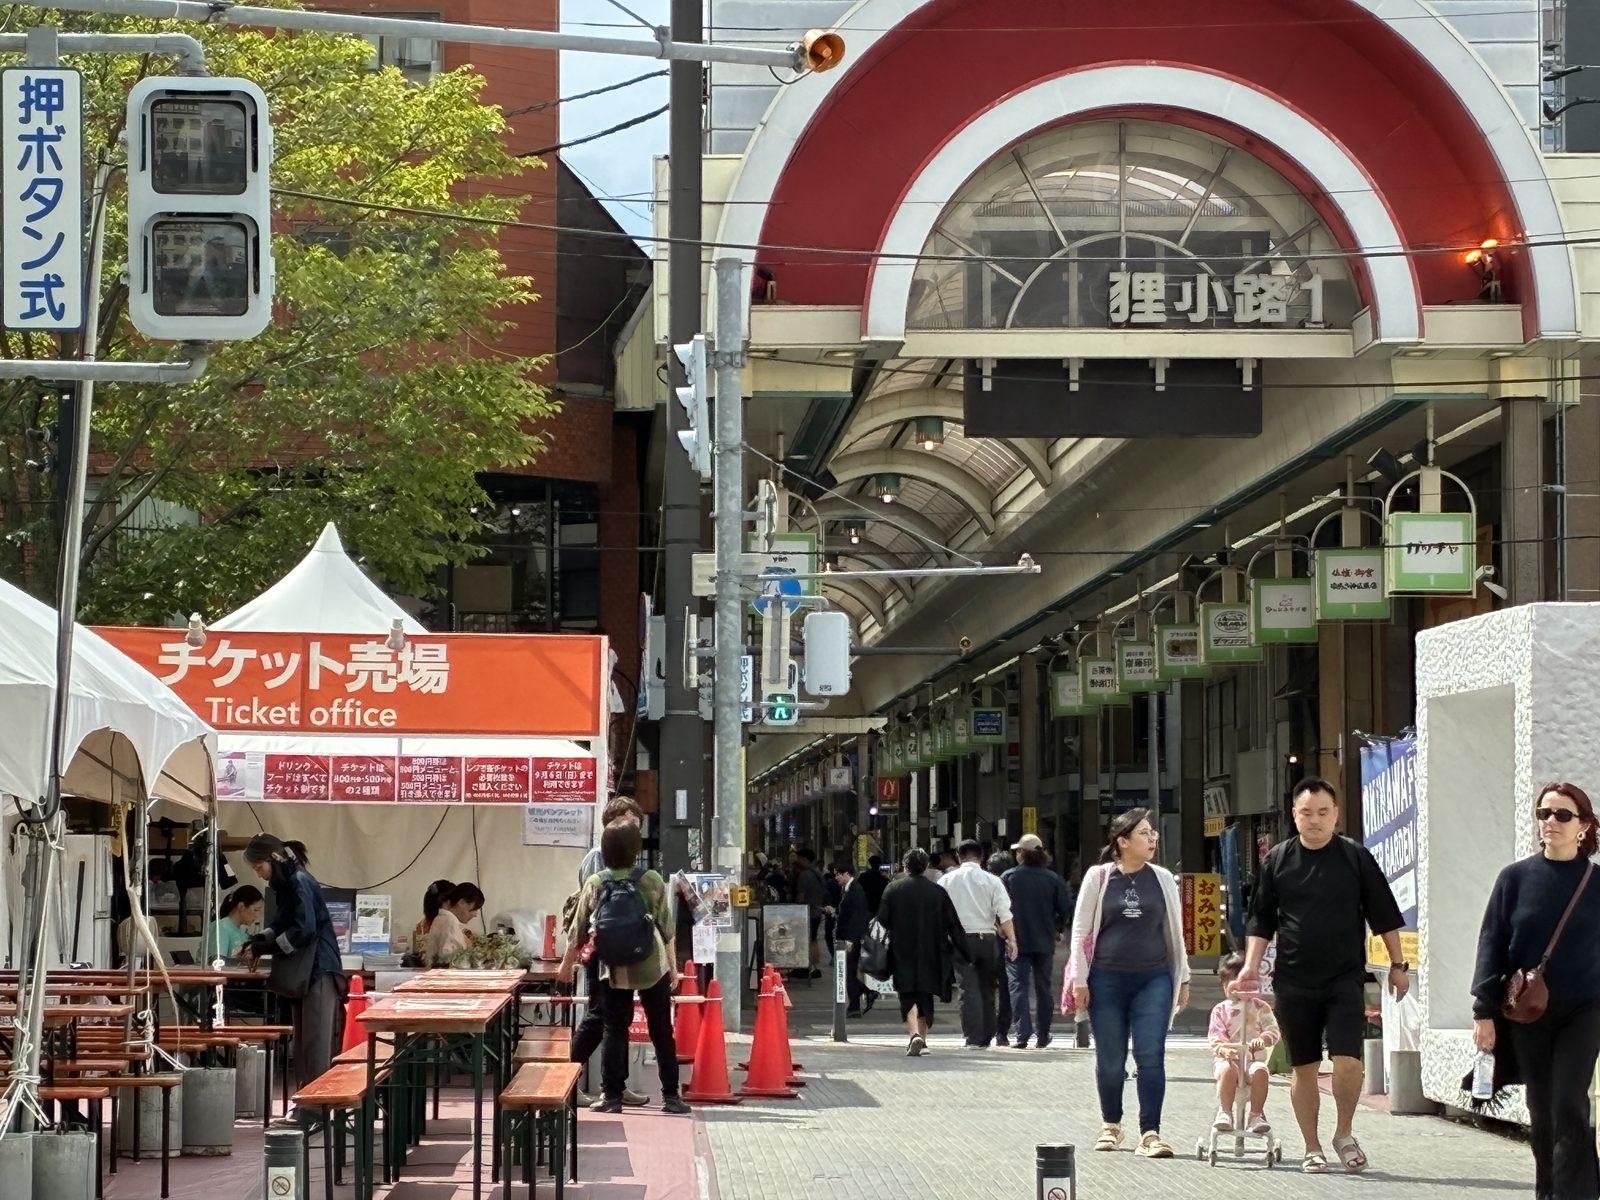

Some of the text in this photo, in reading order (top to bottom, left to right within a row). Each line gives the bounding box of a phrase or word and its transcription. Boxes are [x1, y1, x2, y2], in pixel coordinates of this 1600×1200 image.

[17, 76, 66, 322] 押ボタン式
[157, 639, 450, 695] チケット売場
[205, 696, 398, 727] Ticket office
[266, 773, 327, 783] フードはすべて
[340, 763, 385, 773] チケットは
[546, 761, 582, 770] チケットは
[1362, 755, 1408, 839] OKINAWA
[1385, 820, 1414, 878] GARDEN
[1198, 879, 1216, 951] おみやげ
